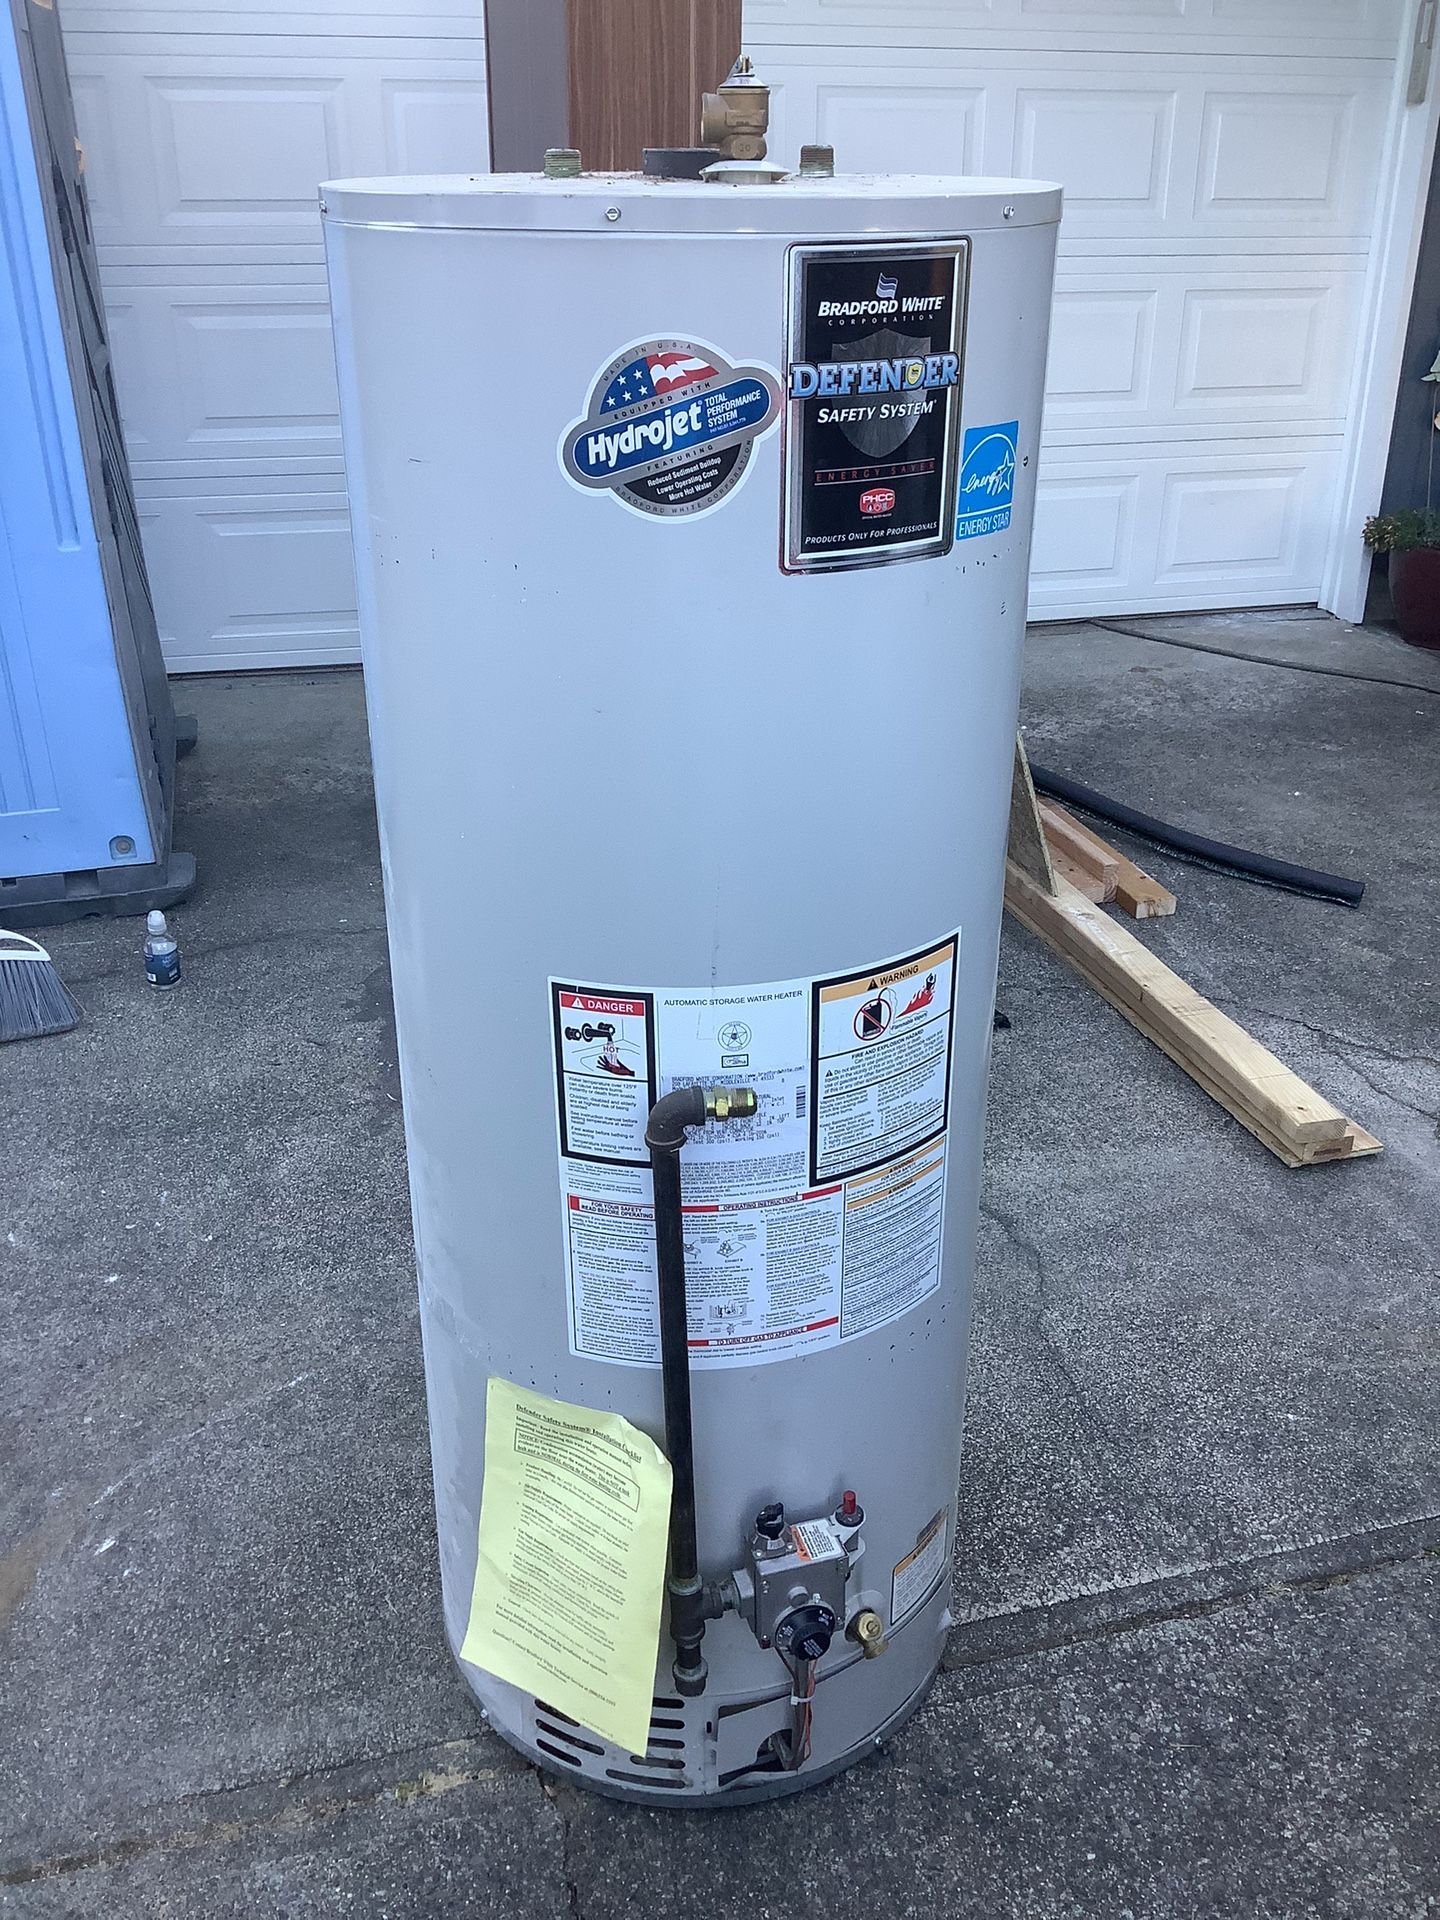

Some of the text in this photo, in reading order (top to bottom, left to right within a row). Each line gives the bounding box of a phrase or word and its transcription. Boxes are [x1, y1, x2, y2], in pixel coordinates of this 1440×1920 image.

[818, 296, 943, 317] BRADFORD WHITE
[828, 314, 934, 326] CORPORATION
[603, 343, 697, 383] MADE IN U.S.A.
[790, 352, 958, 399] DEFENDER
[614, 382, 711, 420] EQUIPPED WITH
[705, 393, 727, 406] TOTAL
[707, 389, 761, 417] PERFORMANCE
[708, 410, 738, 427] SYSTEM
[817, 401, 934, 424] SAFETY SYSTEM
[587, 402, 702, 468] Hydrojet
[647, 444, 714, 471] FEATURING
[615, 440, 752, 514] BRADFORD WHITE CORPORATION
[647, 473, 672, 487] Reduced
[672, 463, 699, 478] Sediment
[656, 468, 718, 495] Lower Operating Costs
[816, 462, 935, 482] ENERGY SAVER
[668, 480, 712, 501] More Hot Water
[863, 493, 893, 503] PHCC
[805, 521, 937, 545] PRODUCTS ONLY FOR PROFESSIONALS
[959, 510, 1009, 537] ENERGY STAR
[879, 965, 918, 986] WARNING
[588, 1001, 633, 1013] DANGER
[709, 997, 745, 1005] STORAGE
[747, 994, 772, 1003] WATER
[774, 990, 802, 999] HEATER
